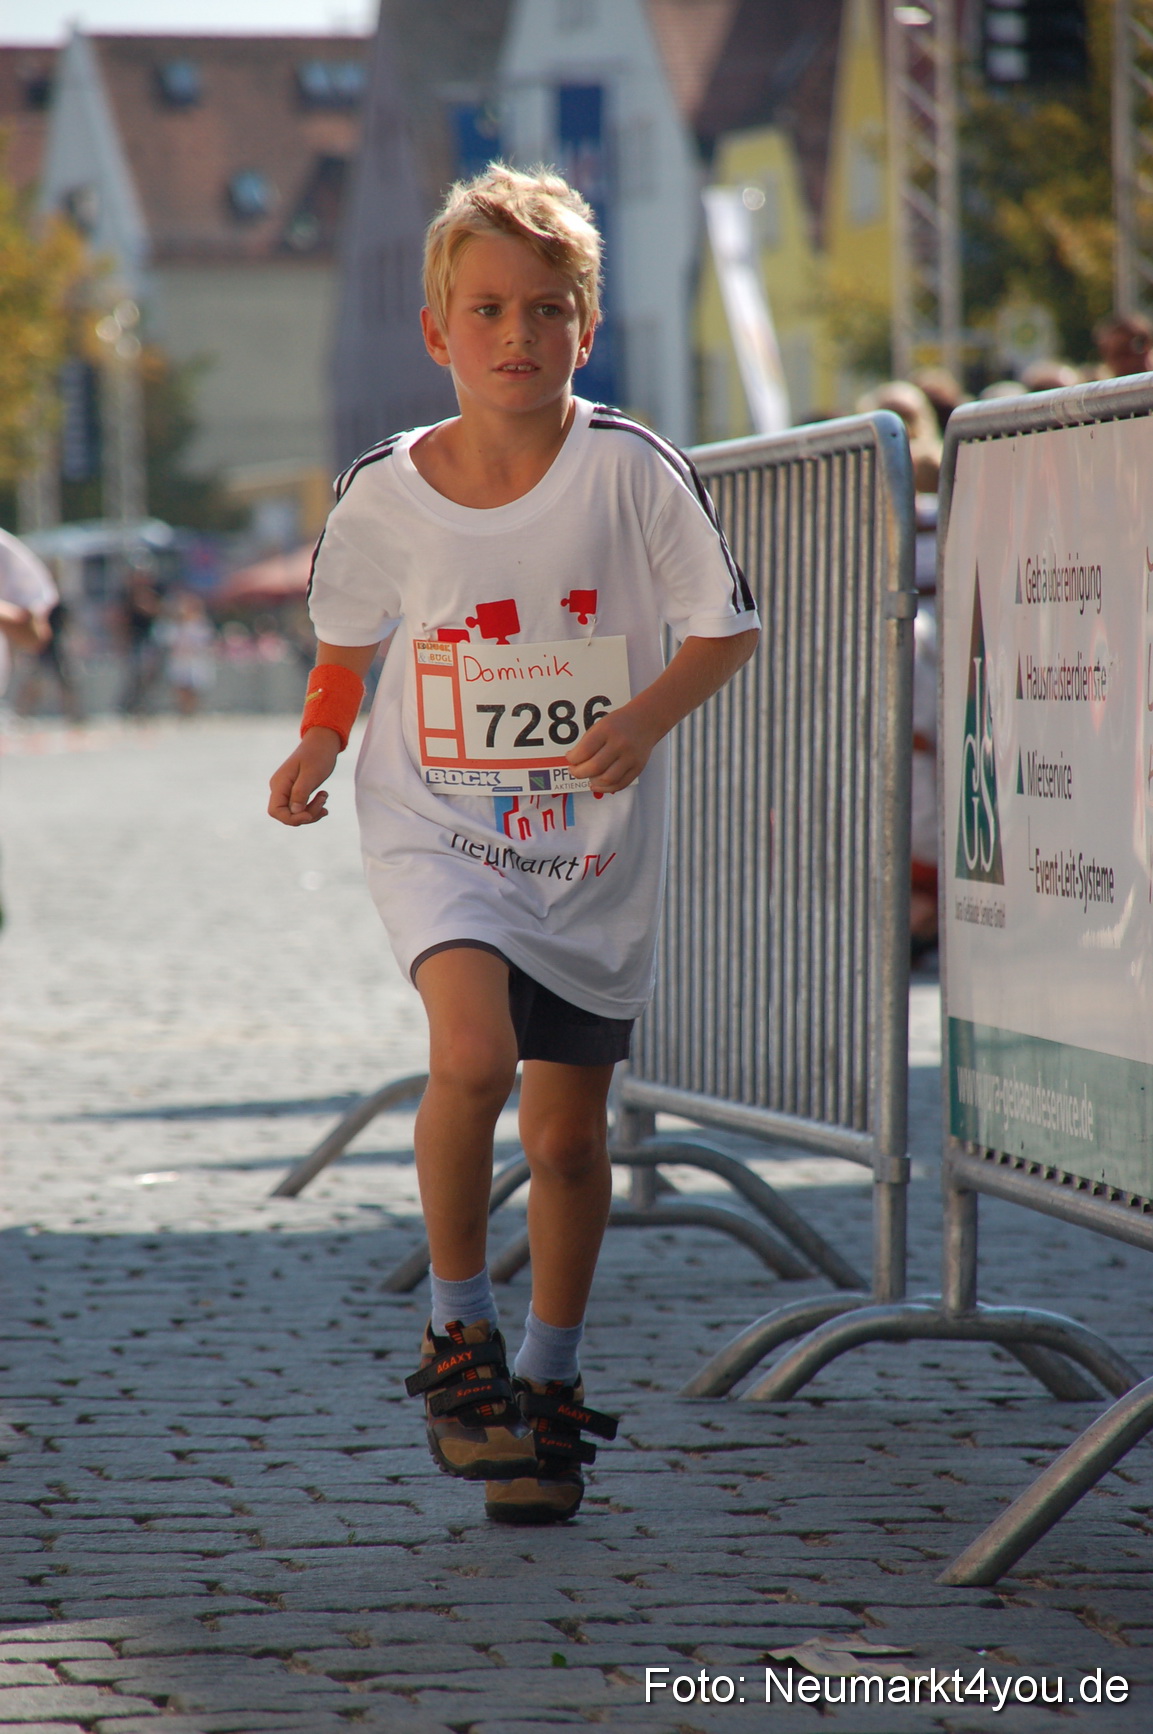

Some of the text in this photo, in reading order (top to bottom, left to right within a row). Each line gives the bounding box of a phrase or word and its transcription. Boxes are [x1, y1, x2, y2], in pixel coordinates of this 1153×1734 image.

[1025, 553, 1102, 615] Gebäudereinigung
[463, 654, 573, 682] Dominik
[1026, 651, 1107, 701] Hausmeisterdienste
[426, 768, 502, 787] BOCK
